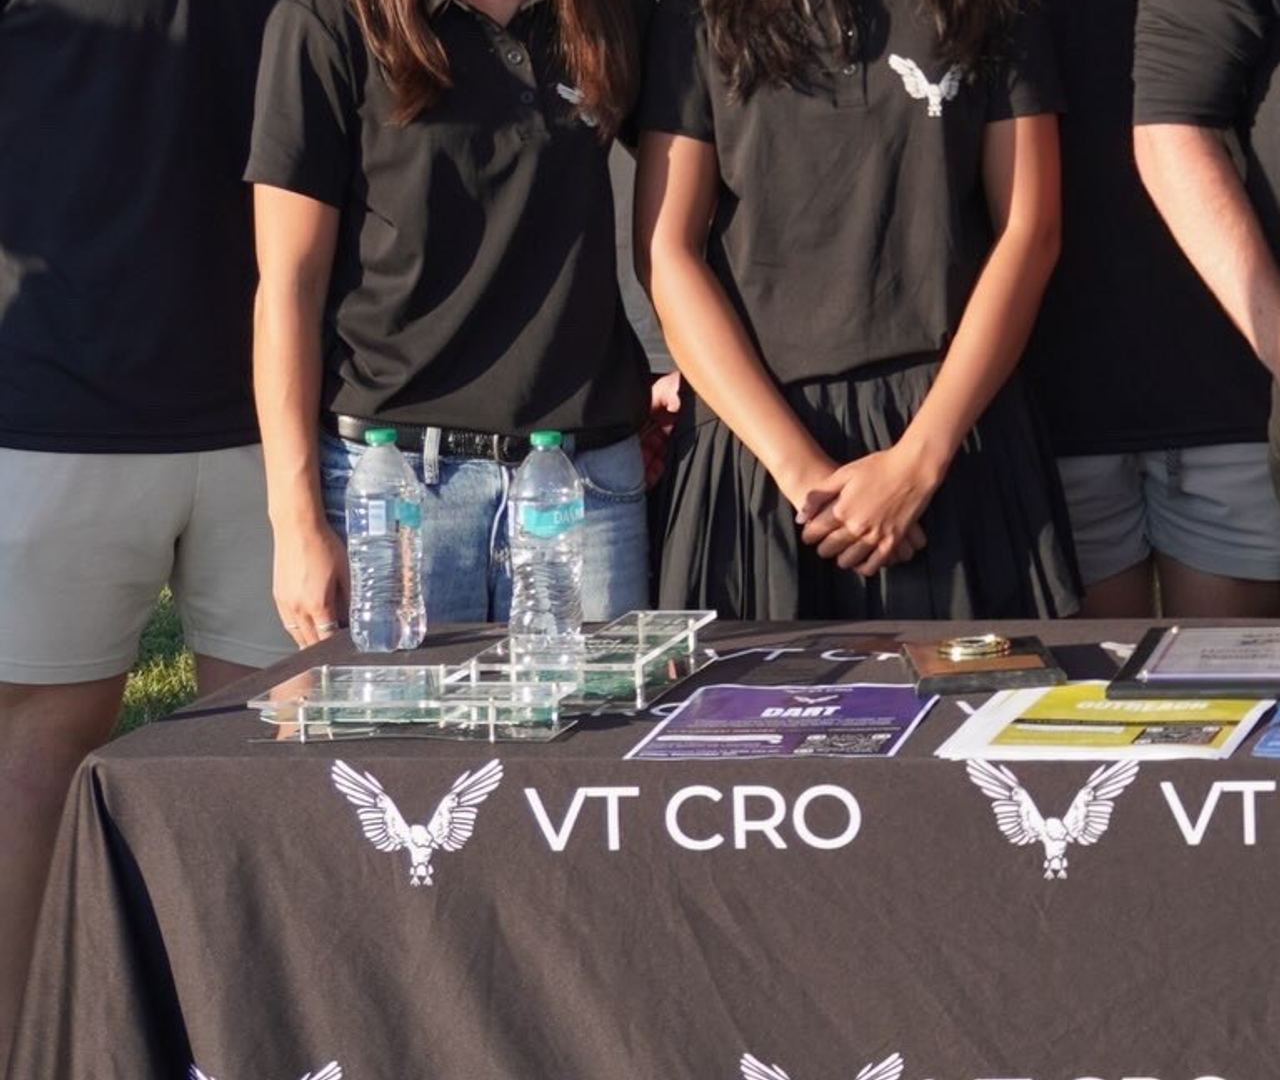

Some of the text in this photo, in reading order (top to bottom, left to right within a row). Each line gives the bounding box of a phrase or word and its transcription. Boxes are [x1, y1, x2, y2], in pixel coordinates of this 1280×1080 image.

[759, 706, 842, 719] DART
[1076, 699, 1212, 713] OUTREACH
[524, 784, 863, 853] VT CRO
[1160, 781, 1278, 847] VT
